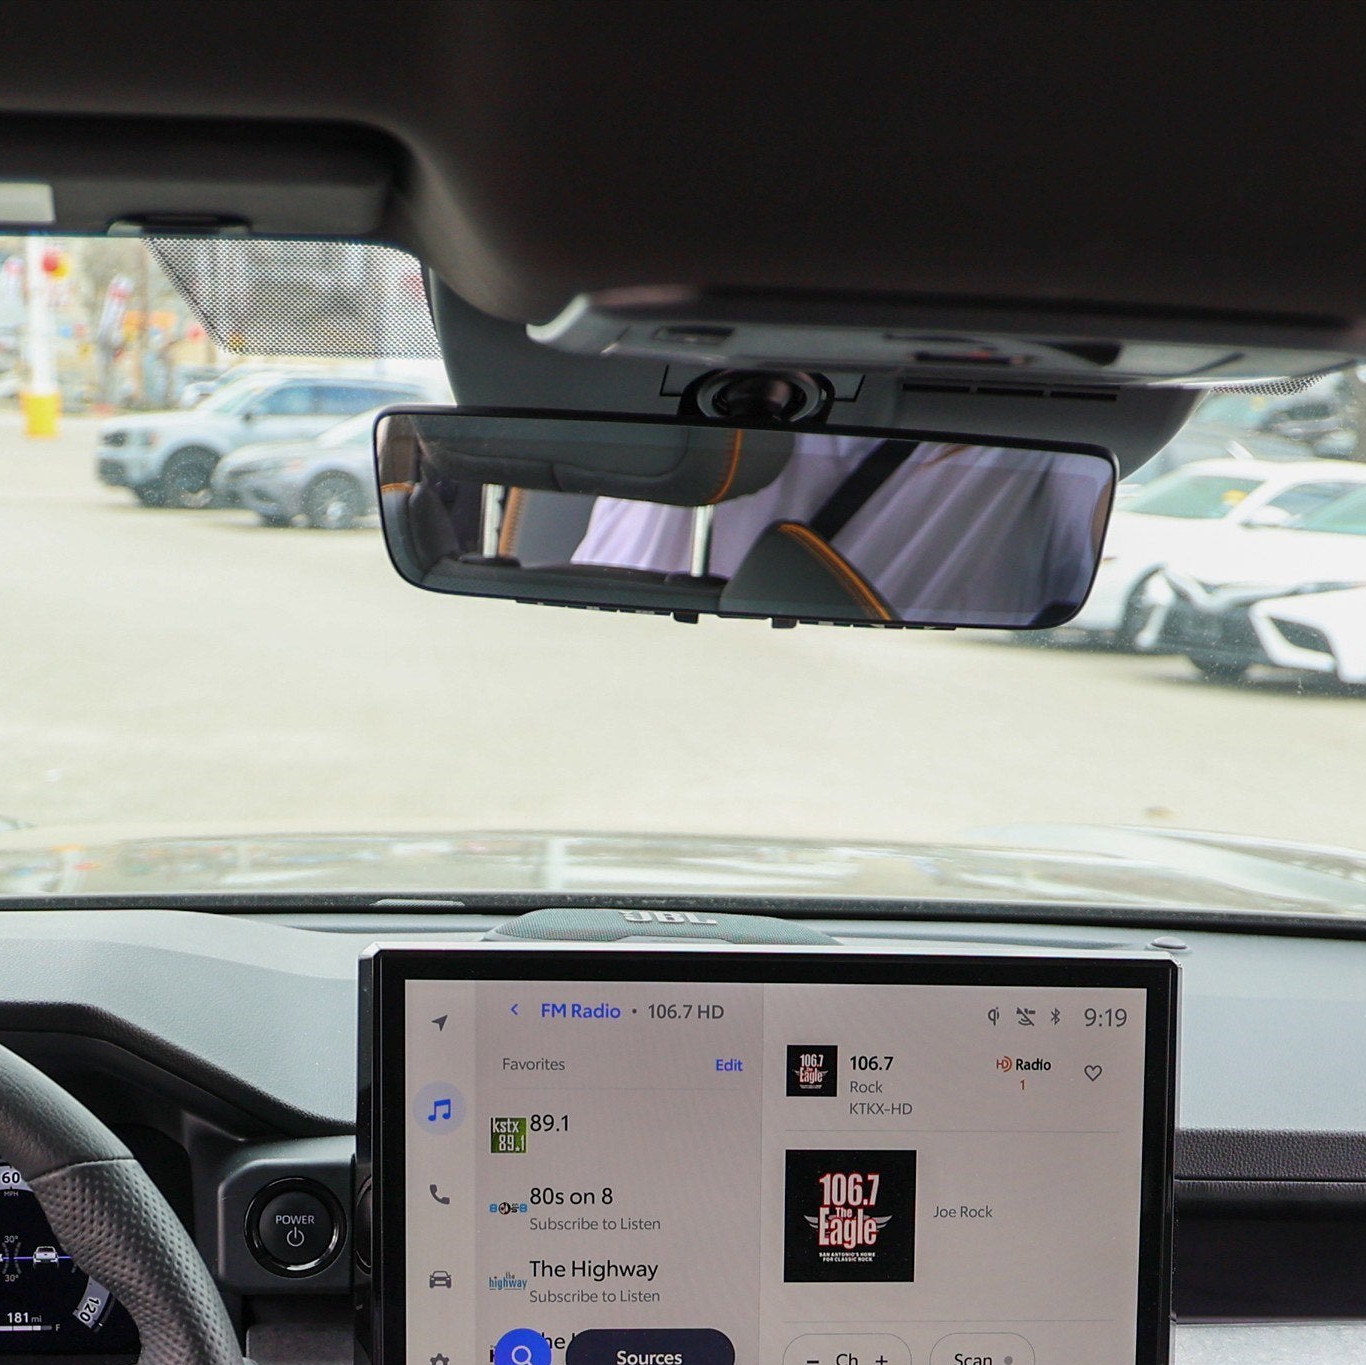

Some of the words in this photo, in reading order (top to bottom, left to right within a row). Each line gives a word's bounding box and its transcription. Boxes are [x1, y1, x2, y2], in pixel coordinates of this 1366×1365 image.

[541, 1003, 566, 1018] FM
[571, 1002, 621, 1019] Radio
[647, 1003, 692, 1020] 106.7
[697, 1004, 725, 1019] HD
[1084, 1007, 1128, 1028] 9:19
[502, 1057, 566, 1071] Favorites
[715, 1058, 743, 1072] Edit
[799, 1053, 824, 1069] 106.7
[849, 1056, 894, 1071] 106.7
[1015, 1057, 1052, 1072] Radio
[799, 1066, 823, 1086] Eagle
[849, 1080, 883, 1094] Rock
[1020, 1079, 1026, 1091] 1
[849, 1102, 913, 1116] KTKX-HD
[492, 1118, 520, 1134] kstx
[530, 1114, 569, 1132] 89.1
[498, 1134, 526, 1152] 89.1
[0, 1171, 21, 1185] 60
[529, 1187, 564, 1205] 80s
[570, 1192, 595, 1205] on
[601, 1187, 613, 1205] 8
[818, 1173, 880, 1207] 106.7
[275, 1214, 315, 1225] POWER
[835, 1206, 853, 1218] The
[933, 1205, 957, 1219] Joe
[960, 1205, 993, 1219] Rock
[529, 1217, 599, 1231] Subscribe
[602, 1218, 617, 1231] to
[620, 1217, 661, 1231] Listen
[818, 1206, 878, 1250] Eagle
[529, 1260, 566, 1277] The
[571, 1260, 659, 1282] Highway
[489, 1276, 528, 1290] highway
[529, 1289, 599, 1303] Subscribe
[602, 1290, 617, 1303] to
[620, 1289, 661, 1303] Listen
[78, 1296, 100, 1323] 120
[6, 1312, 29, 1324] 181
[31, 1313, 42, 1323] mi
[616, 1350, 683, 1365] Sources
